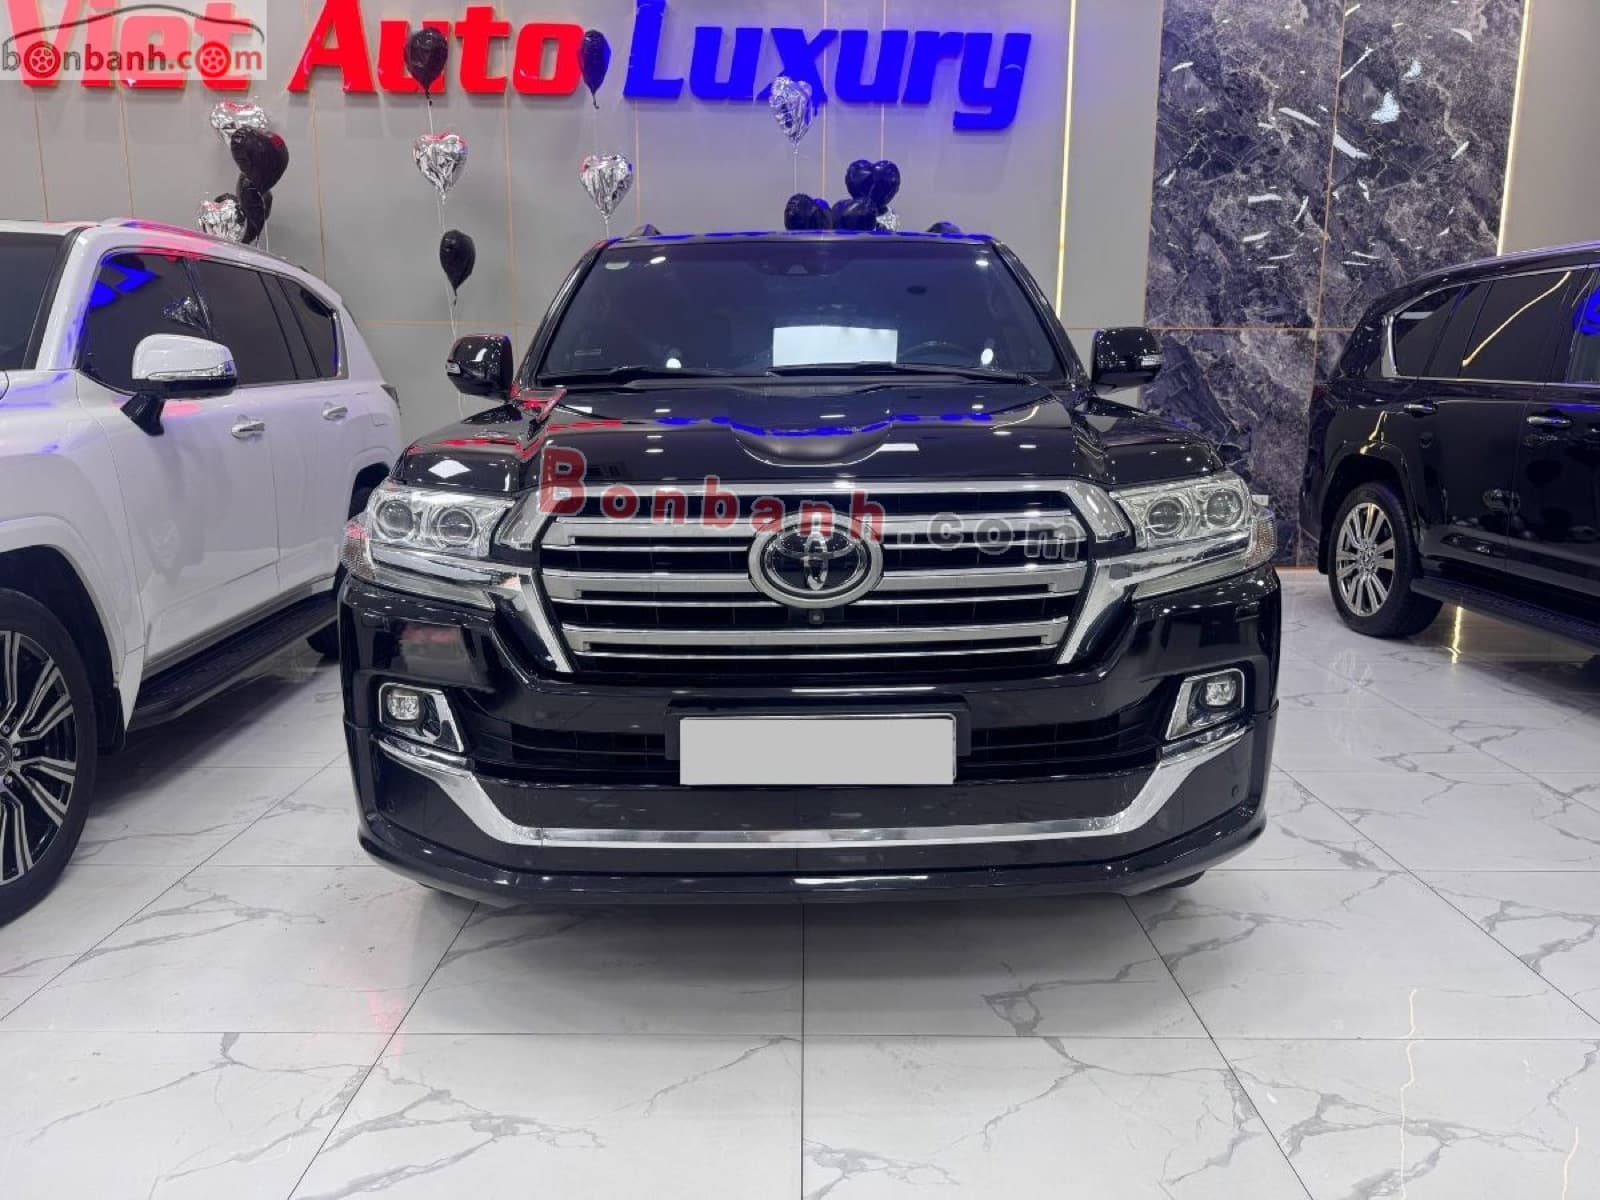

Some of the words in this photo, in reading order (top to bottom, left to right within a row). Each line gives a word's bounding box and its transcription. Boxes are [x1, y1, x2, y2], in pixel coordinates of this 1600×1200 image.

[7, 0, 254, 90] Viet
[287, 0, 584, 95] Auto
[622, 0, 1032, 131] Luxury
